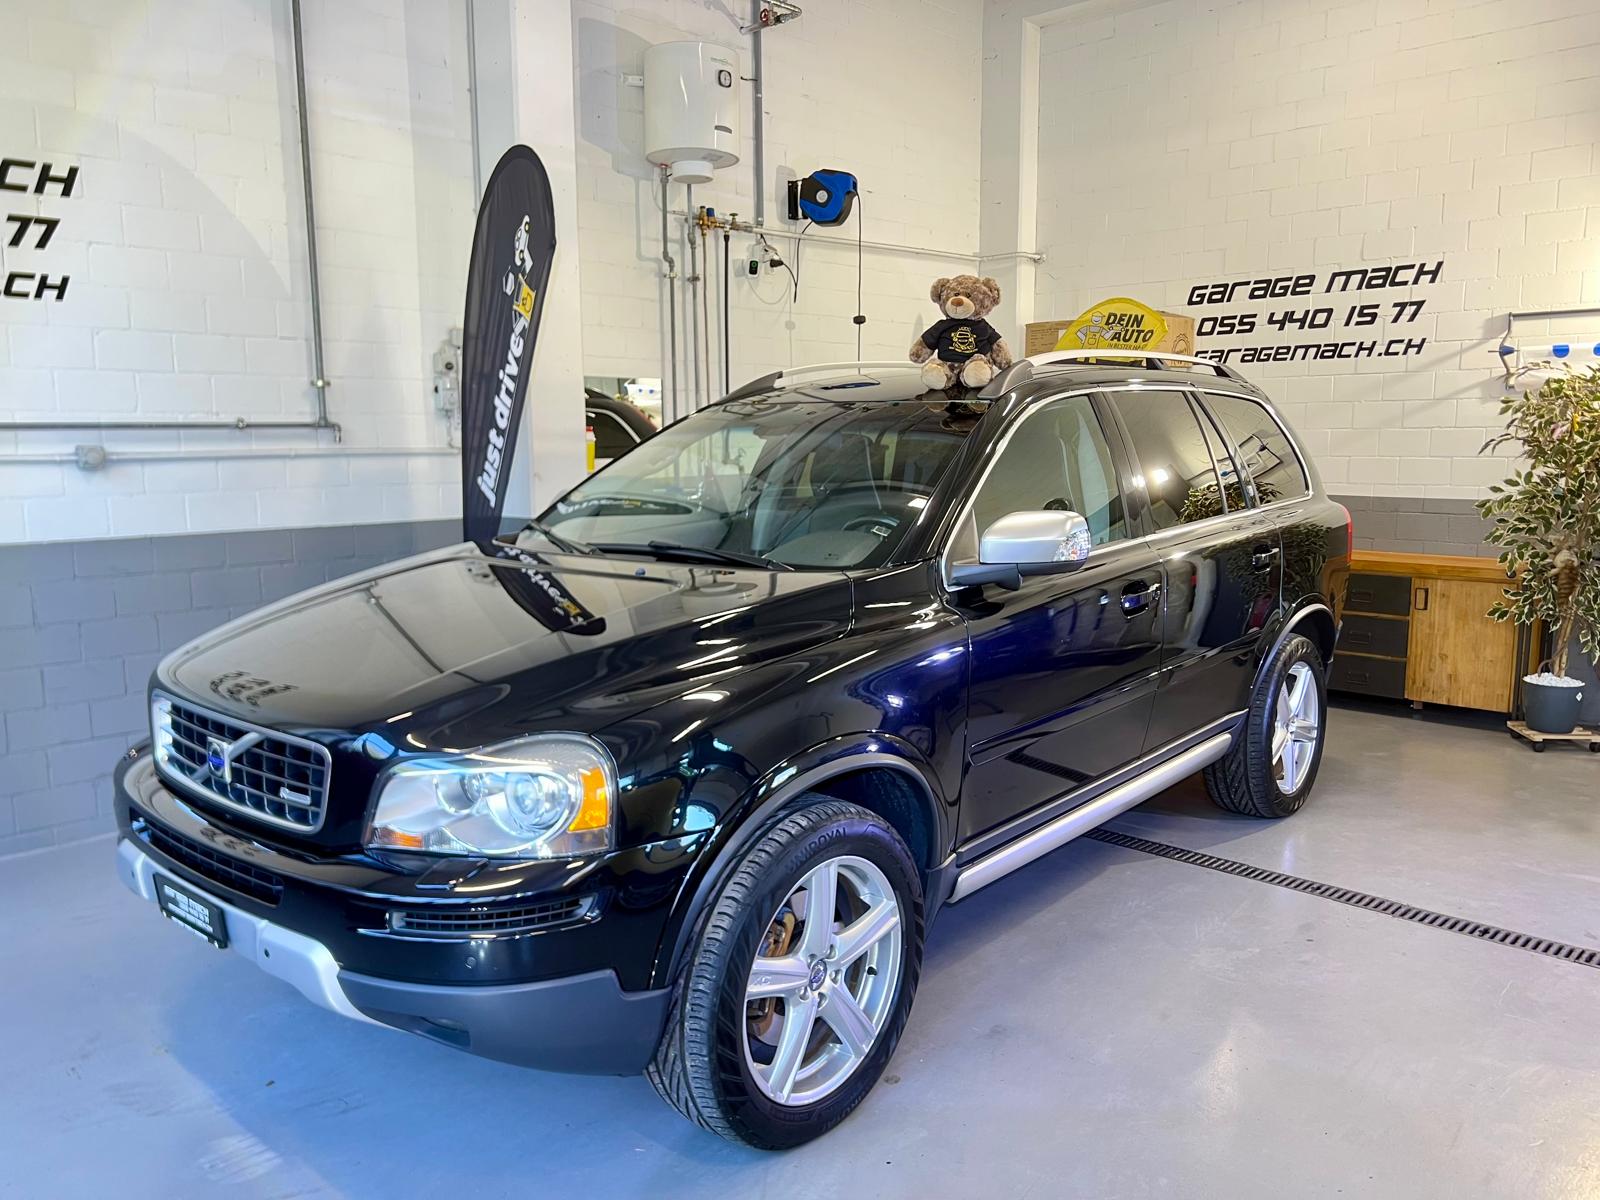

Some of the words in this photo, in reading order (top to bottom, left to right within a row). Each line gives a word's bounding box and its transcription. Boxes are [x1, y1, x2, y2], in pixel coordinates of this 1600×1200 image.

[6, 214, 60, 250] 77
[0, 271, 70, 301] CH
[1104, 312, 1145, 329] DEIN
[1196, 313, 1258, 337] 055
[1267, 307, 1334, 331] 440
[1391, 299, 1427, 323] 77
[1110, 328, 1154, 343] AUTO
[477, 428, 505, 509] just
